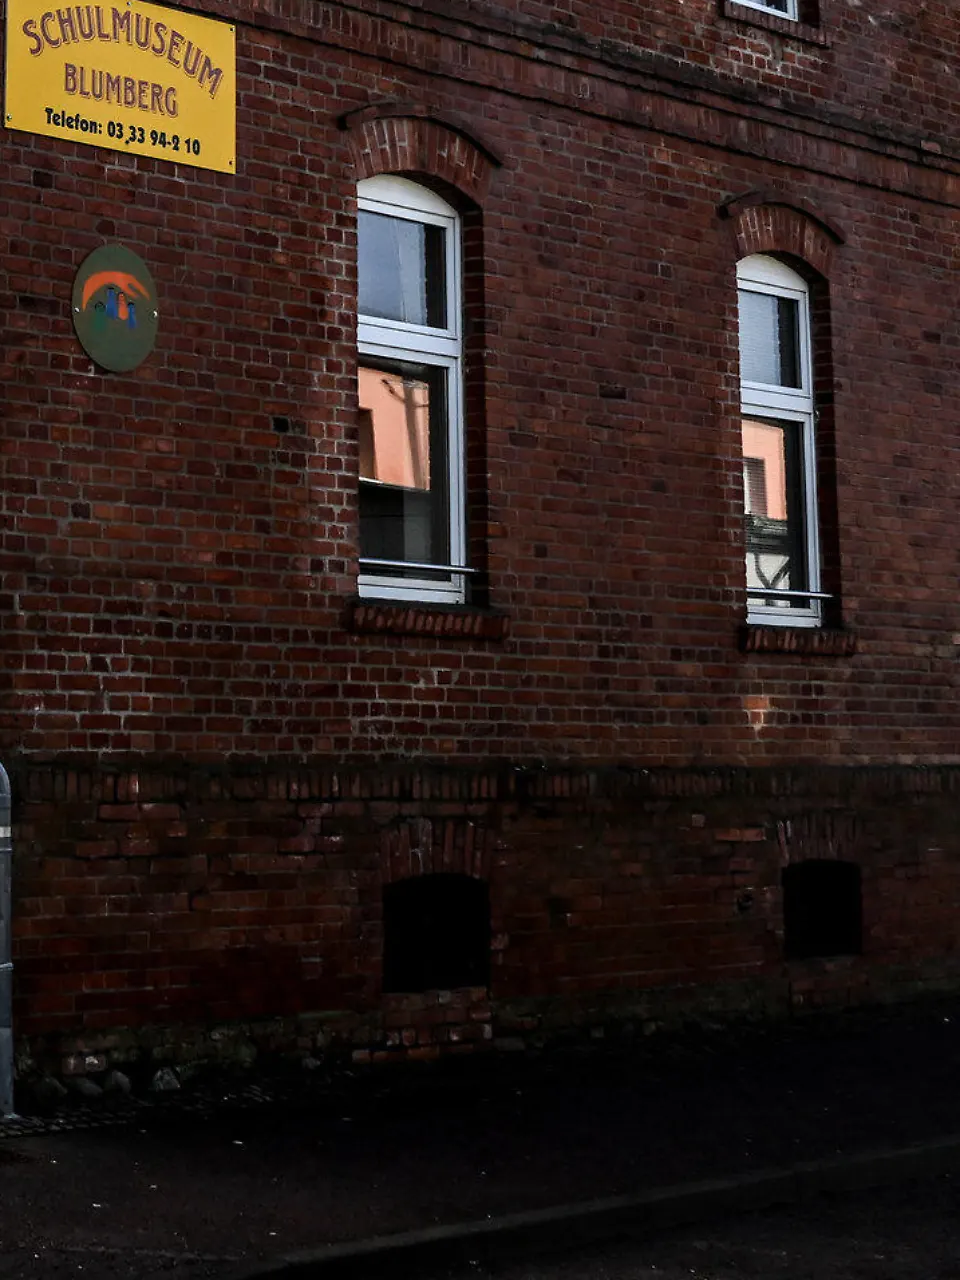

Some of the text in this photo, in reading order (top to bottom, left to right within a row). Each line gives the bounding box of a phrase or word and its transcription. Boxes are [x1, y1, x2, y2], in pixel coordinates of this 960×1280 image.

[22, 5, 223, 99] SCHULMUSEUM
[64, 62, 179, 118] BLUMBERG
[45, 106, 102, 134] Telefon:
[107, 121, 123, 139] 03
[150, 129, 180, 151] 94-2
[184, 137, 201, 156] 10
